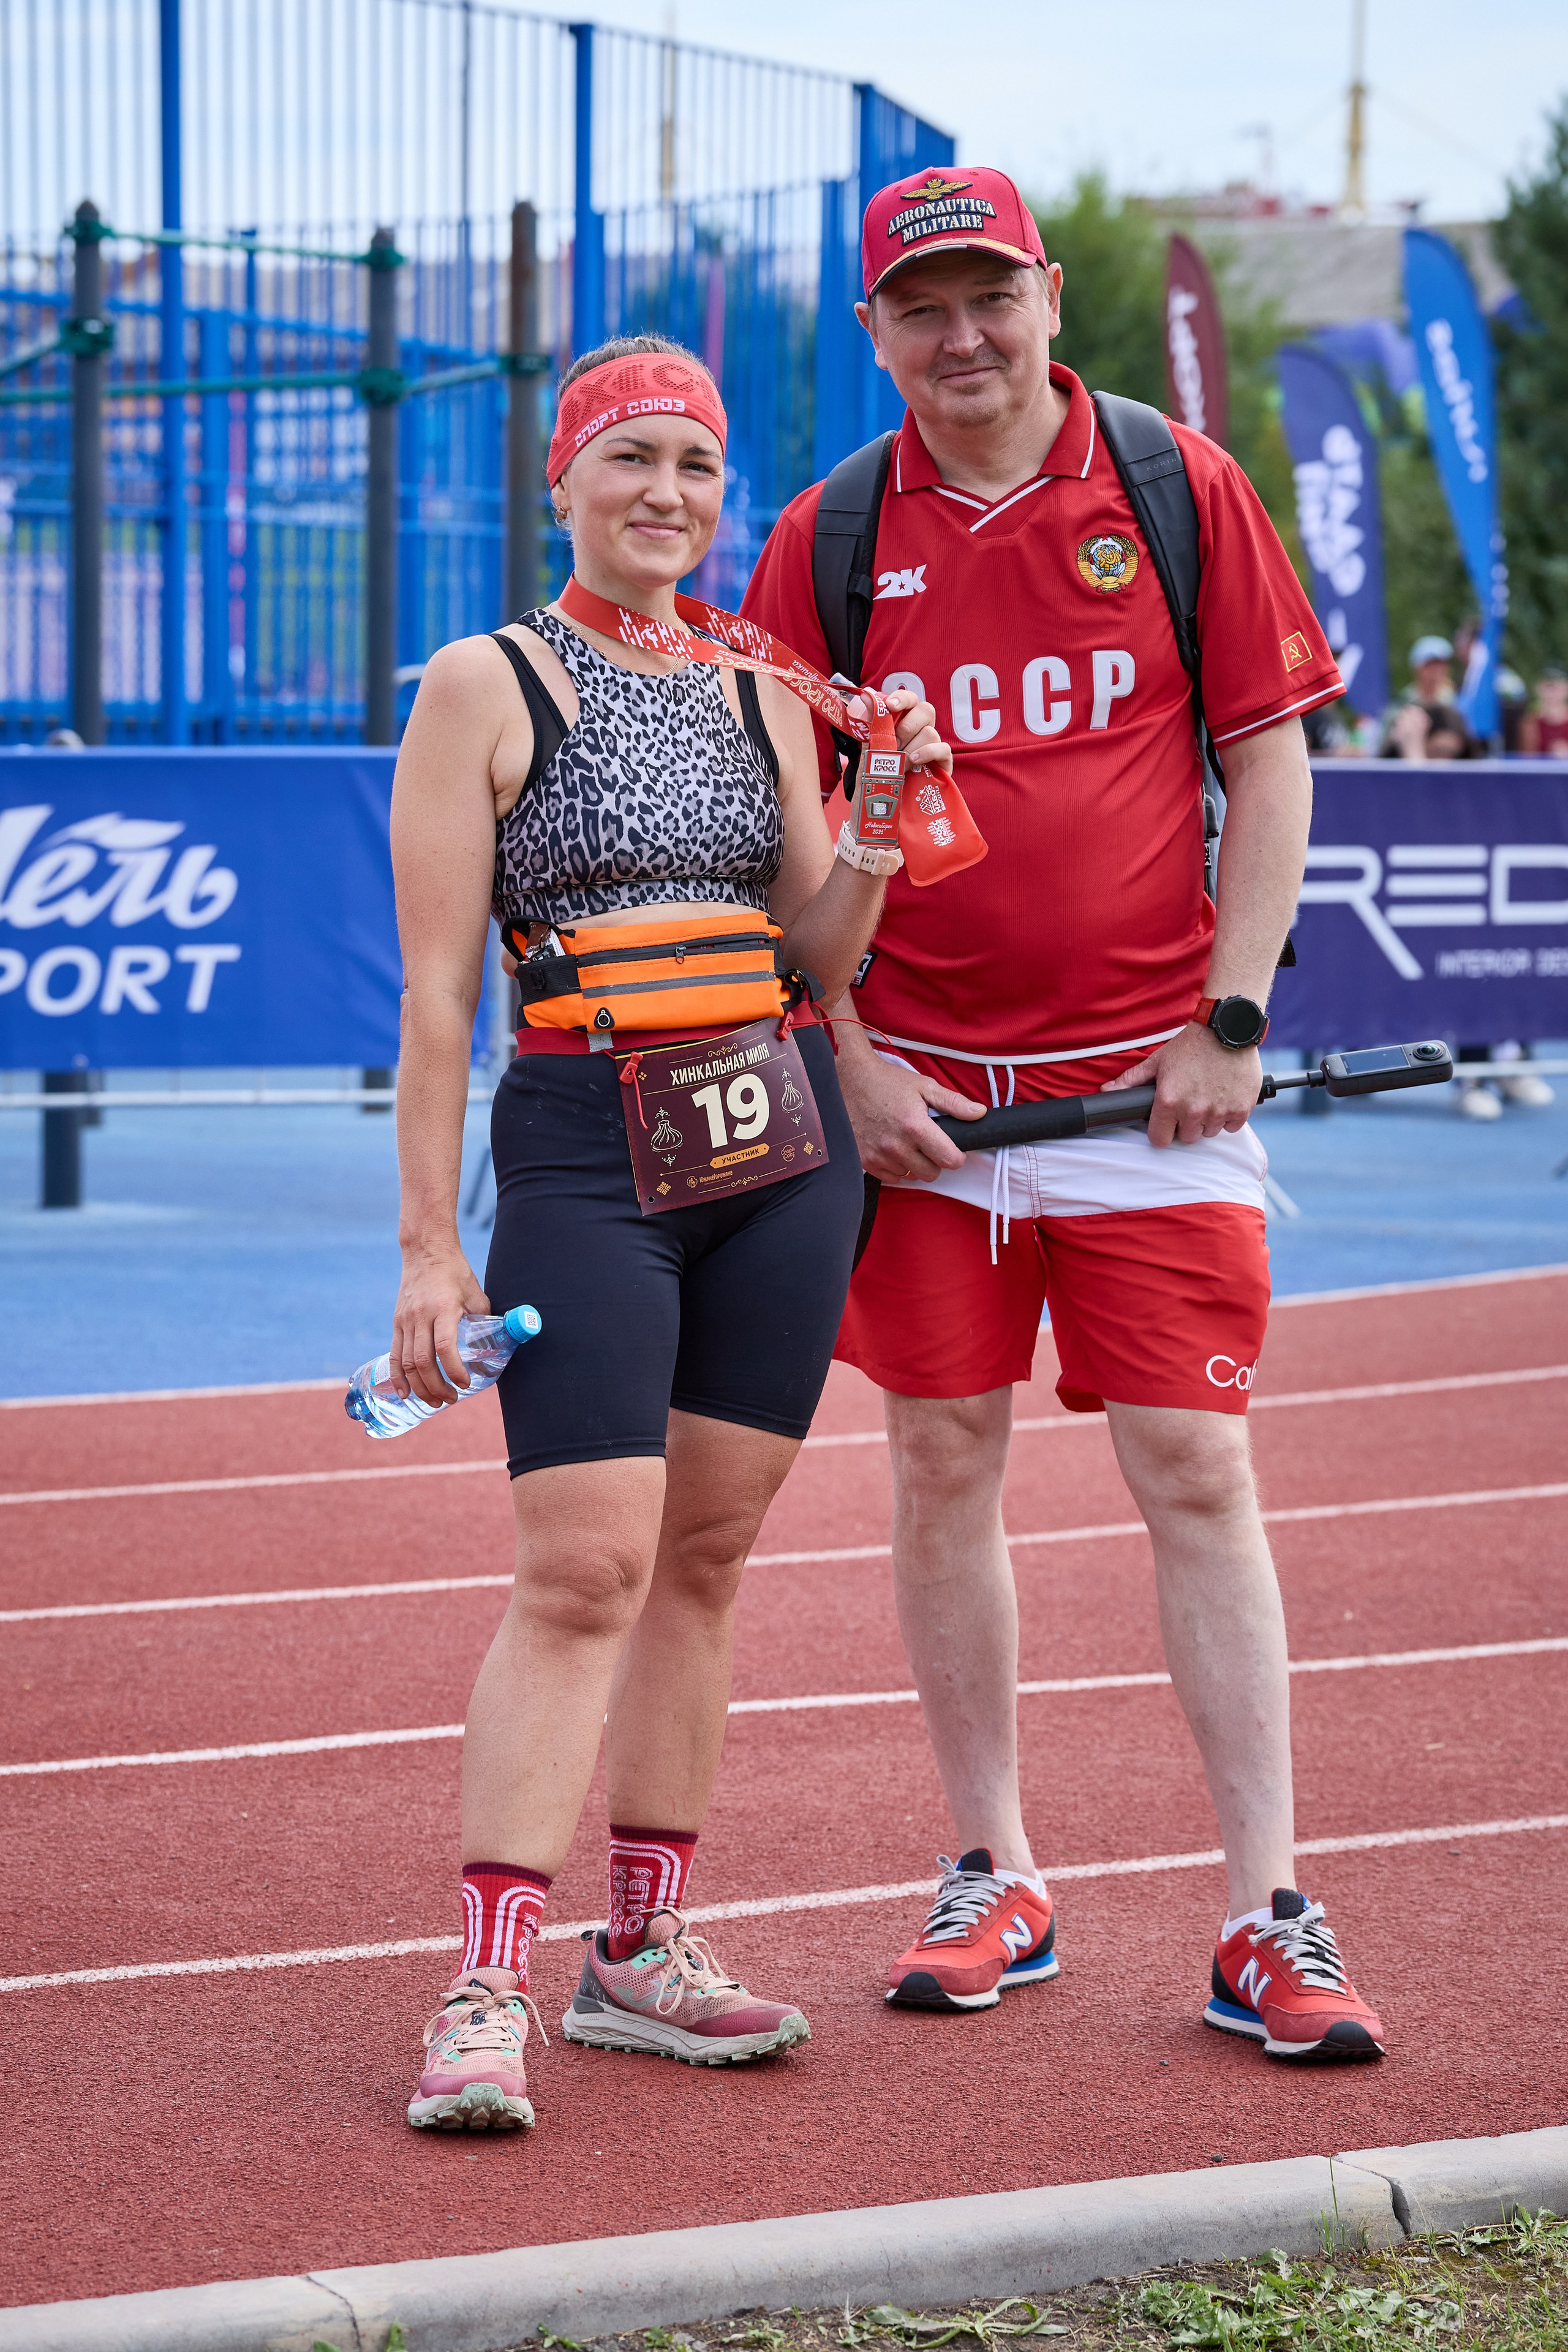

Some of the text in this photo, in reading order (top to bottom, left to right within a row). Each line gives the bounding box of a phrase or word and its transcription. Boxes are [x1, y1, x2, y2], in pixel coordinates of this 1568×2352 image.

[888, 198, 996, 236] AERONAUTICA
[902, 214, 982, 243] MILITARE
[575, 398, 685, 448] СПОРТ СОЮЗ
[1146, 458, 1177, 472] KORIN
[873, 564, 927, 600] 2K
[932, 820, 947, 846] КРОСС
[669, 1043, 770, 1085] ХИНКАЛЬНАЯ МИЛЯ
[692, 1074, 770, 1148] 19
[722, 1148, 760, 1164] УЧАСТНИК
[1205, 1354, 1257, 1390] Cal
[611, 1864, 627, 1938] КРОСС
[624, 1866, 654, 1934] РЕТРО
[519, 1912, 538, 1986] КРОСС
[1236, 1955, 1273, 2011] N
